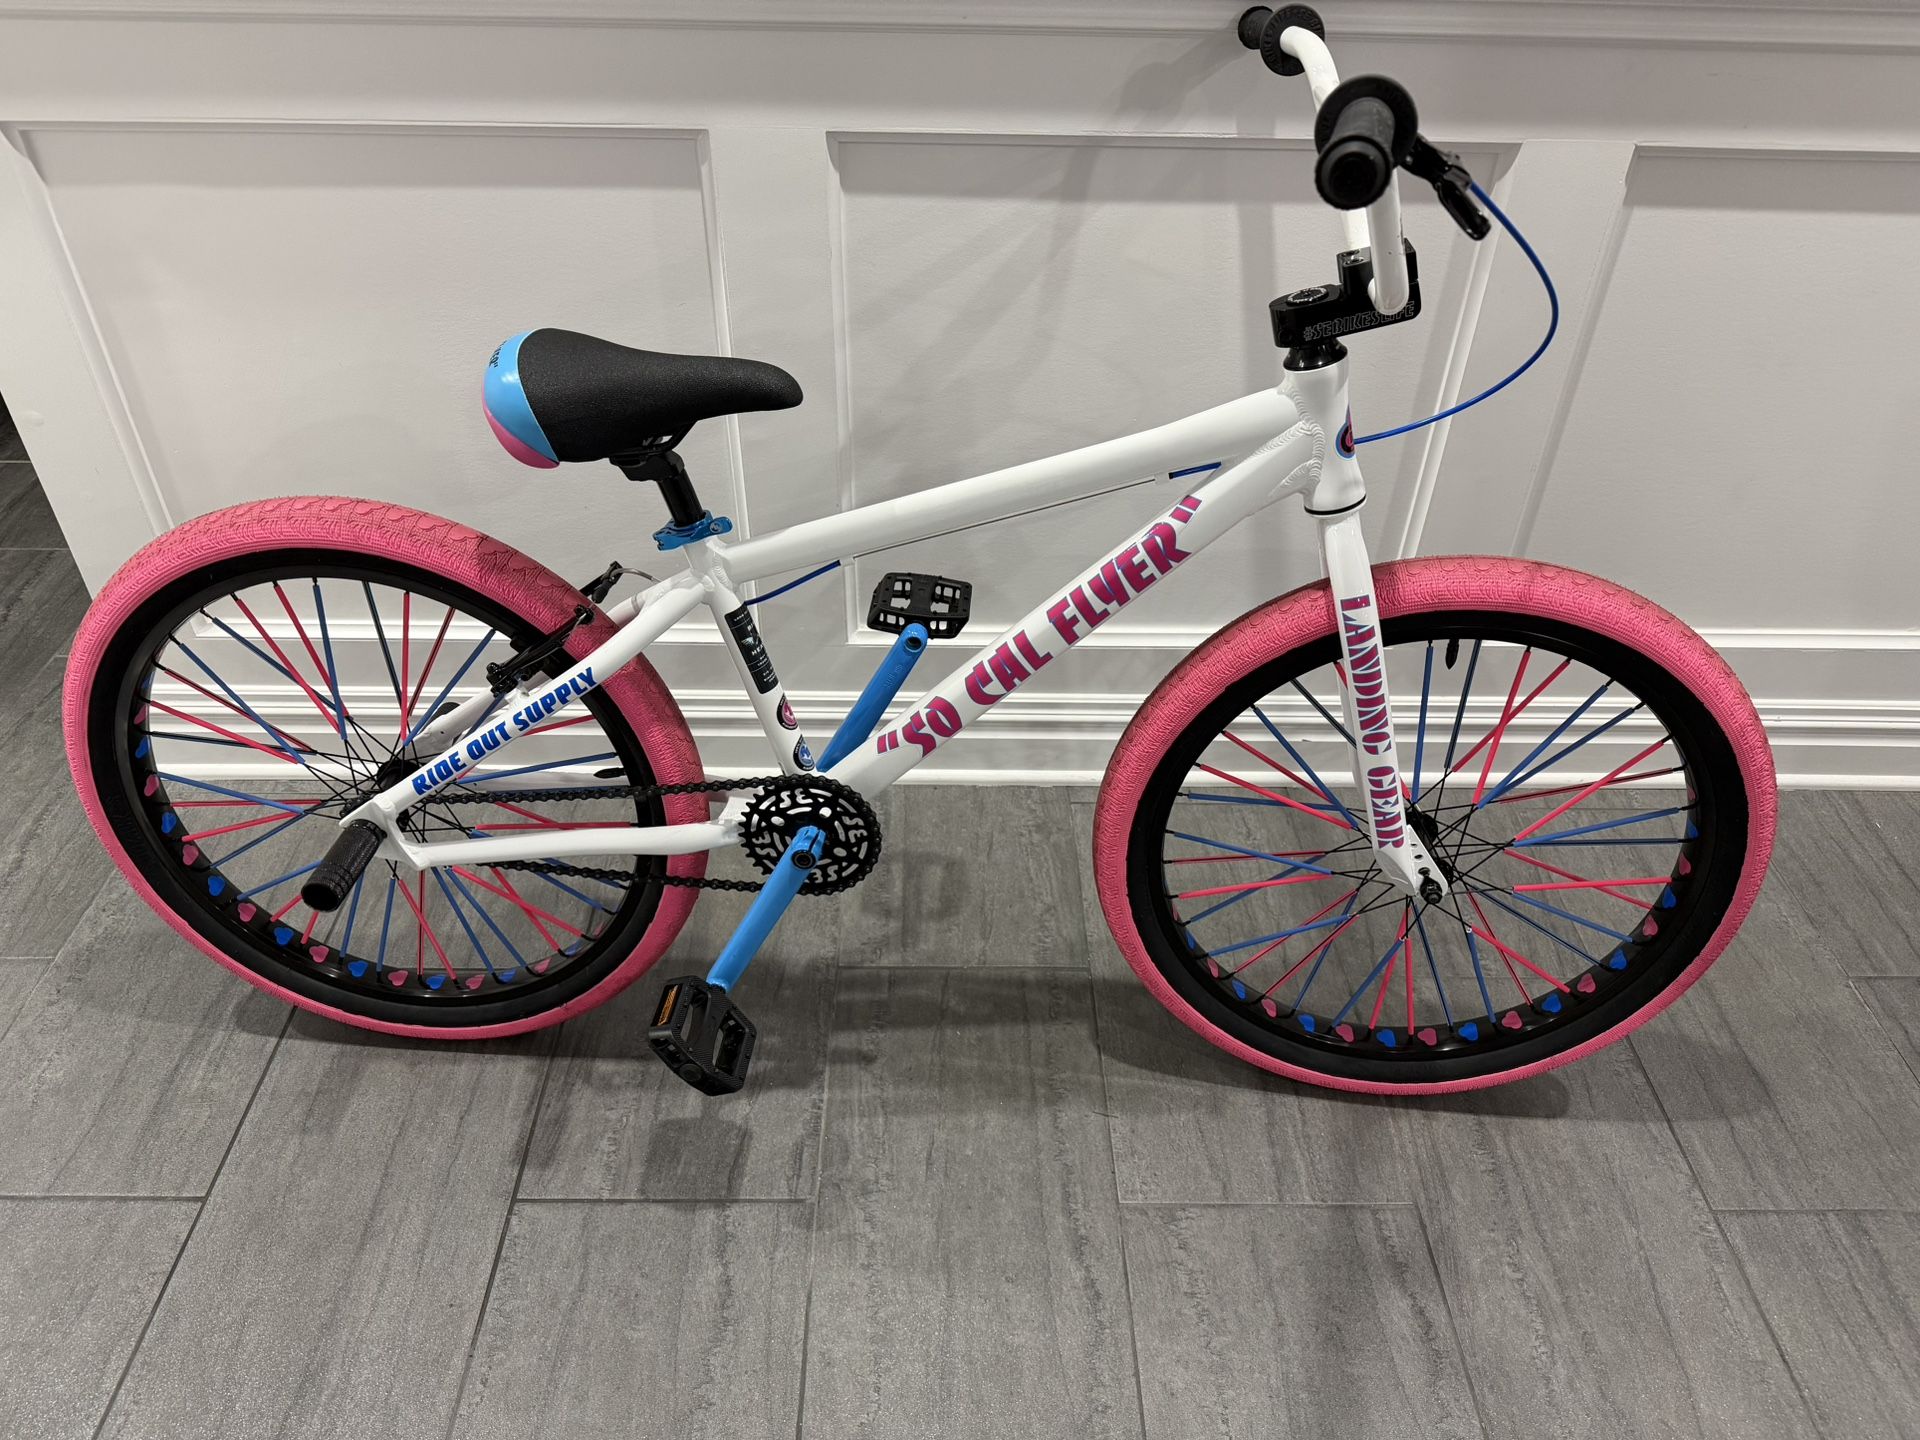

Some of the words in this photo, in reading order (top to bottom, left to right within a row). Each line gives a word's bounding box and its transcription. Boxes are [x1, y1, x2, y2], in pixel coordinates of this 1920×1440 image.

[964, 629, 1053, 706] CAL
[411, 751, 467, 796] RIDE
[466, 721, 513, 761] OUT
[512, 666, 598, 732] SUPPLY
[1340, 594, 1392, 756] LANDING
[1366, 766, 1405, 850] GEAR
[780, 788, 813, 808] SE
[842, 815, 868, 843] SE
